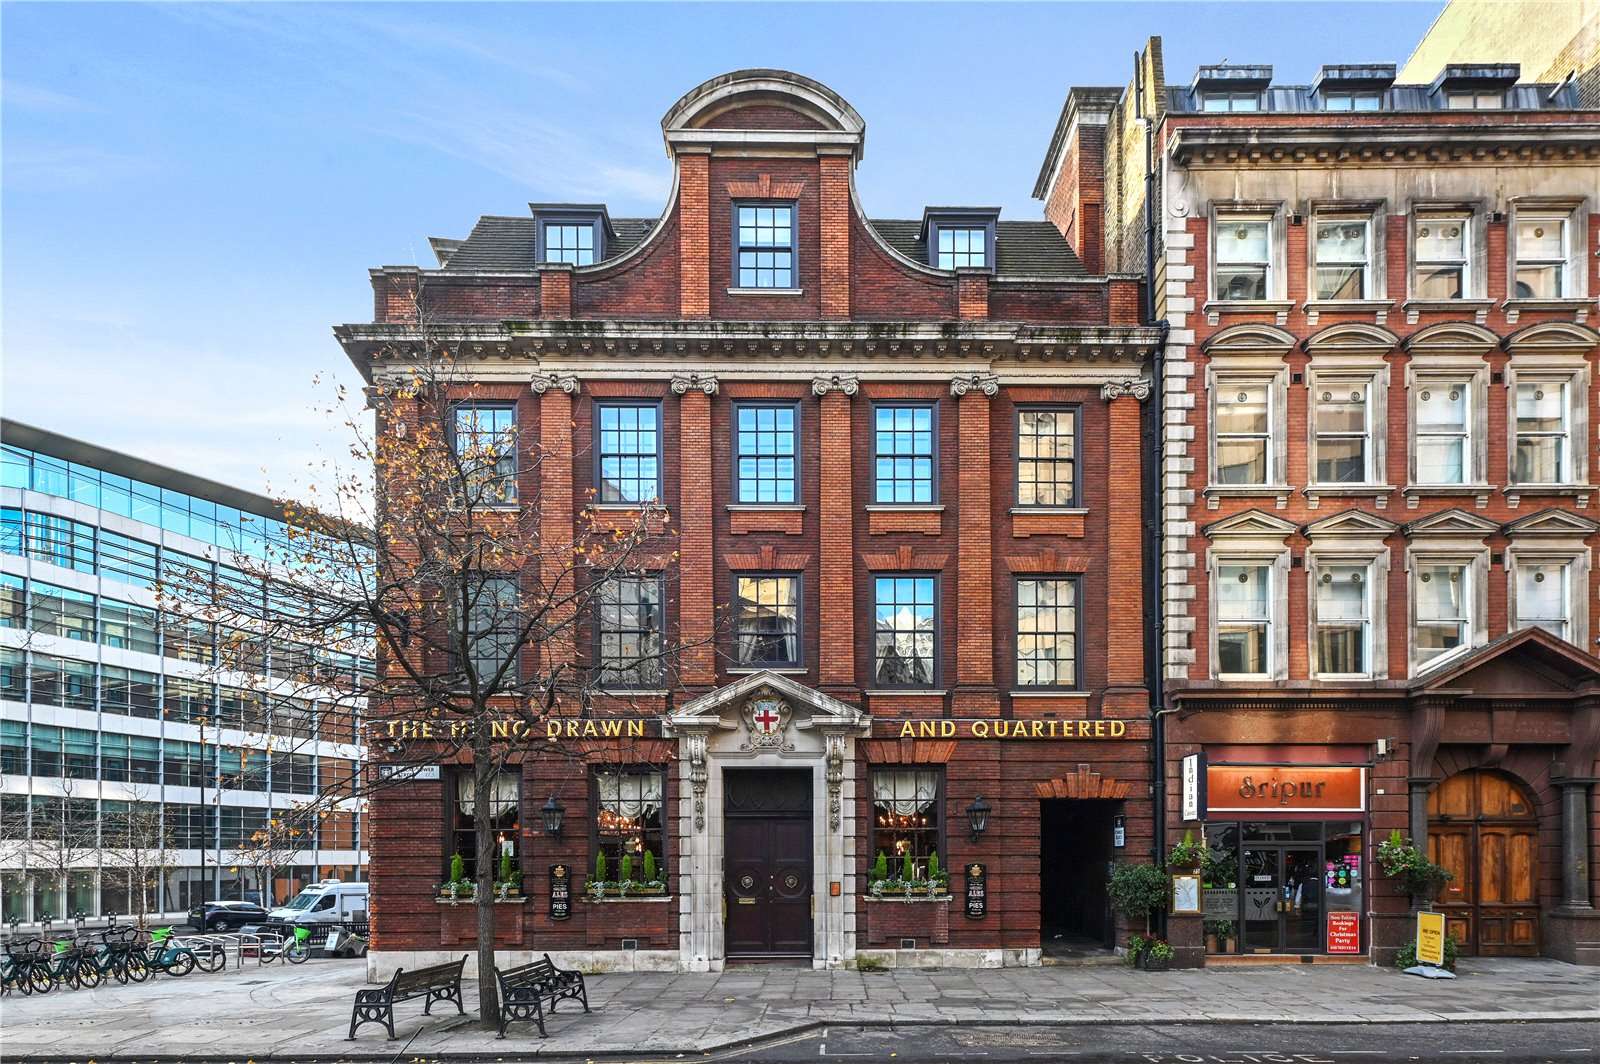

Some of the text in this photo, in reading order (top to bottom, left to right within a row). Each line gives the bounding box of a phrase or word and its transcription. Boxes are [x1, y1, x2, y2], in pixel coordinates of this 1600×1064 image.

[387, 720, 645, 738] THE HNG DRAWN
[899, 720, 1126, 738] AND QUARTERED
[1239, 776, 1326, 805] Sripur
